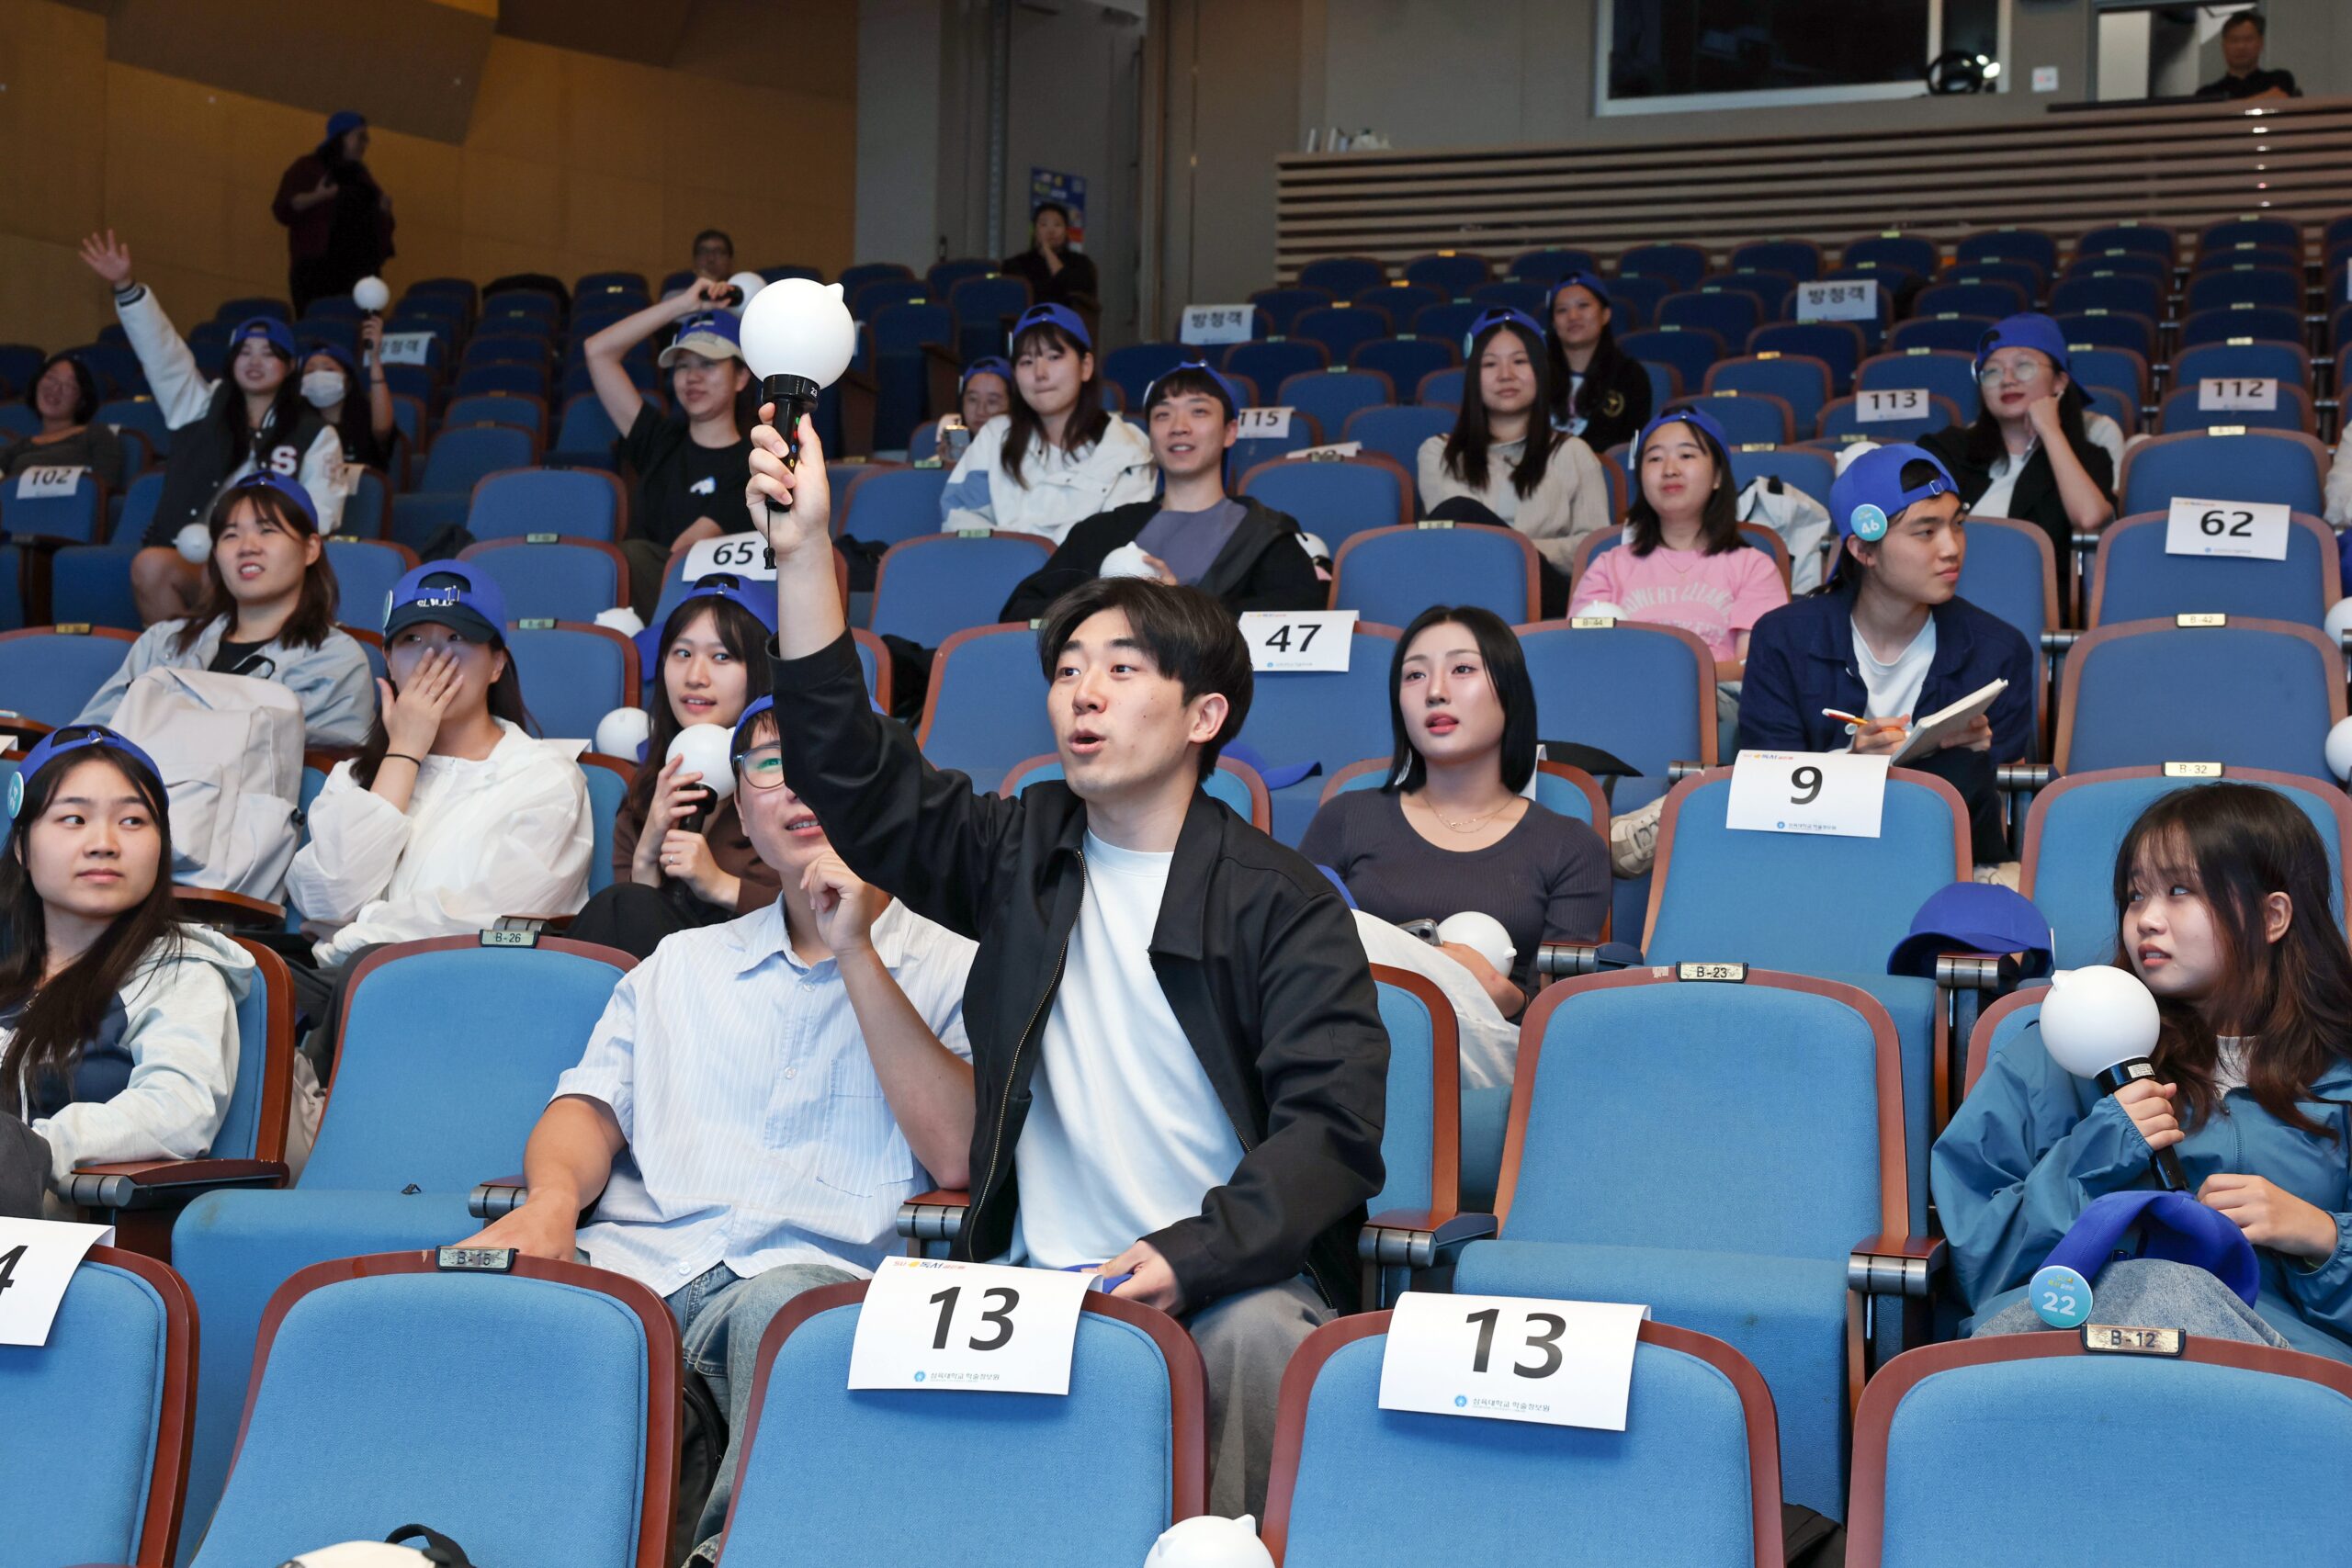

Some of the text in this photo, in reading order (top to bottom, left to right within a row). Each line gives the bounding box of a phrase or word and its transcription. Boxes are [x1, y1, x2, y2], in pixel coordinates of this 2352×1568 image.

[2214, 379, 2263, 397] 112
[1871, 391, 1917, 410] 113
[1240, 411, 1279, 426] 115
[270, 446, 298, 476] S
[31, 469, 72, 485] 102
[1861, 519, 1880, 534] 46
[2200, 510, 2254, 537] 62
[713, 541, 756, 565] 65
[1265, 625, 1322, 652] 47
[2179, 764, 2207, 773] B-32
[1791, 766, 1823, 805] 9
[495, 932, 521, 943] B-26
[1696, 966, 1727, 978] B-23
[457, 1251, 491, 1266] B-15
[2042, 1292, 2075, 1316] 22
[930, 1286, 1020, 1351] 13
[1466, 1308, 1566, 1379] 13
[2110, 1329, 2155, 1348] B-12
